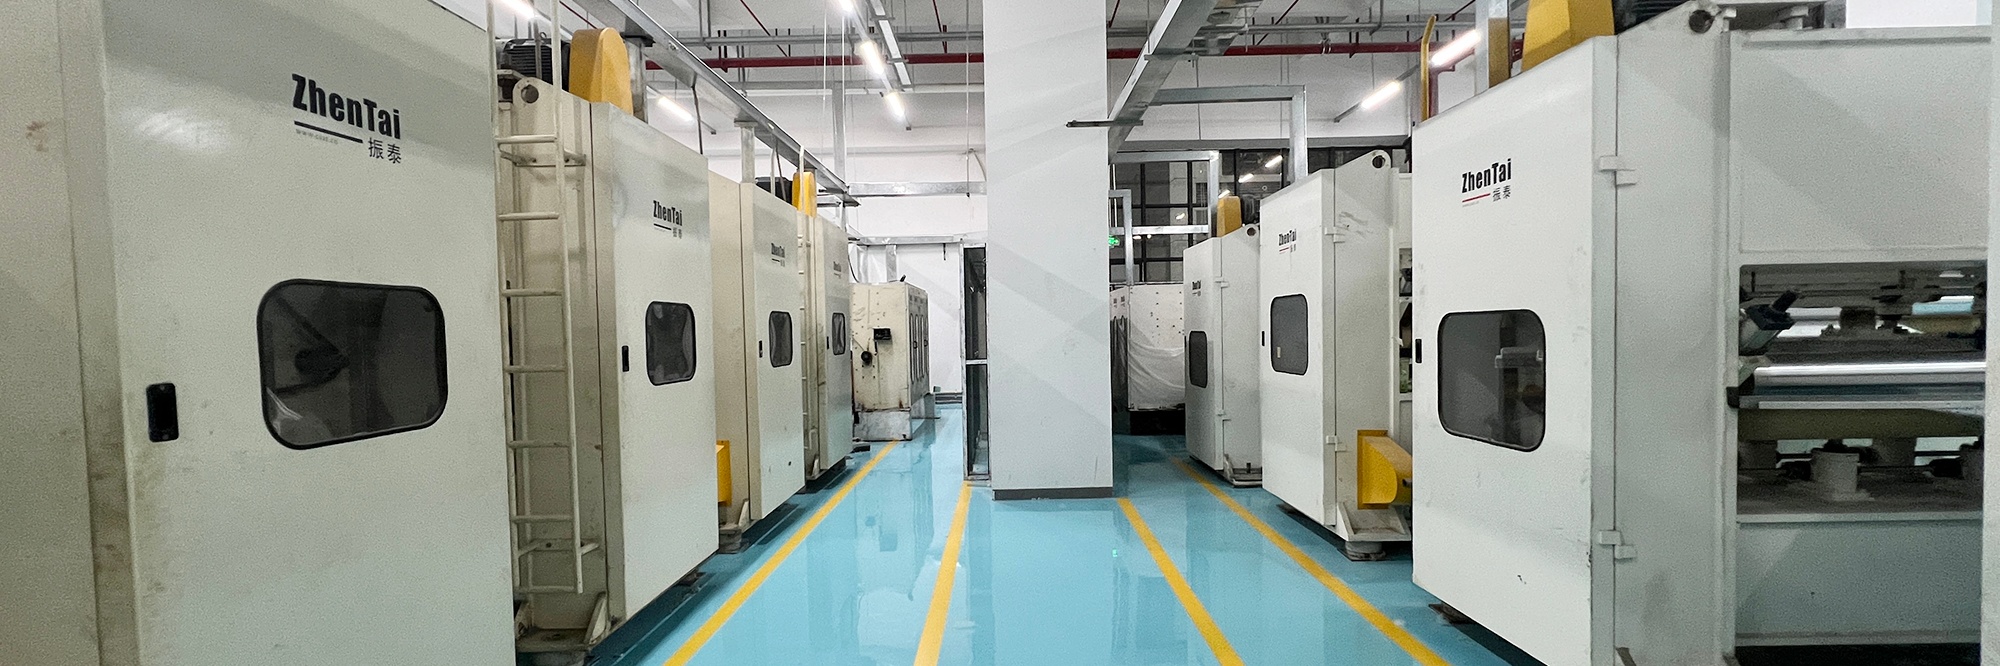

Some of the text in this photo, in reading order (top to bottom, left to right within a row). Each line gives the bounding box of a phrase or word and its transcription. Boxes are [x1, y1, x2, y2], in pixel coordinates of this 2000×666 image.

[292, 73, 401, 140] ZhenTai
[368, 137, 401, 164] 振泰
[1462, 158, 1511, 193] ZhenTai
[653, 200, 682, 226] ZhenTai
